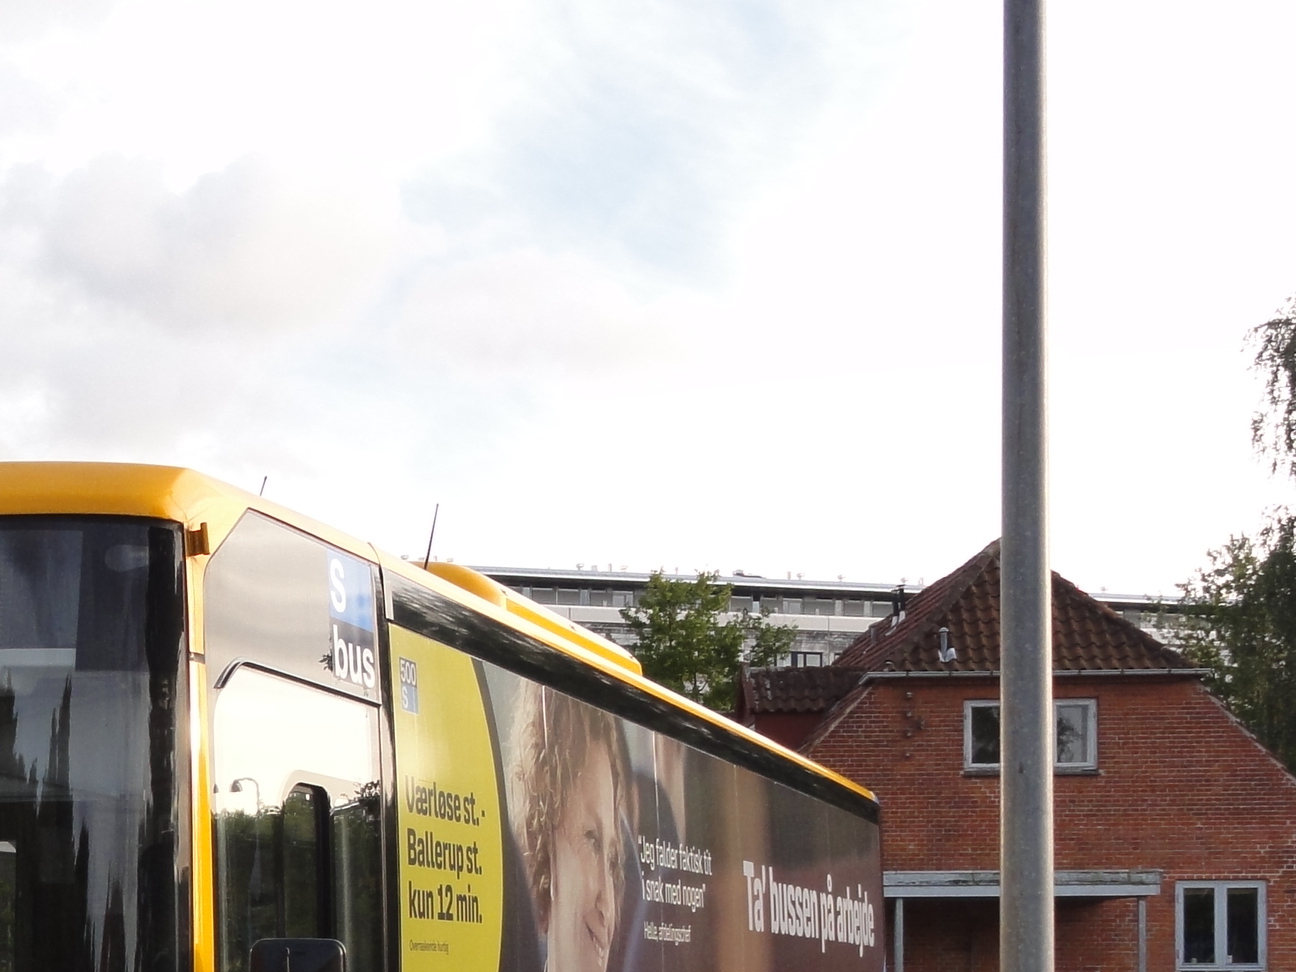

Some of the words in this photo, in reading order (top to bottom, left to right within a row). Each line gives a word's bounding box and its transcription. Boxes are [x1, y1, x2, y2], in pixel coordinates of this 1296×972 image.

[329, 558, 347, 613] S
[332, 624, 376, 688] bus
[400, 660, 417, 686] 500
[405, 775, 461, 823] Værløse
[463, 792, 480, 827] st.
[407, 828, 464, 880] Ballerup
[466, 841, 483, 876] st.
[656, 838, 678, 869] falder
[679, 843, 704, 874] faktisk
[409, 881, 434, 919] kun
[437, 884, 453, 920] 12
[456, 884, 483, 923] min.
[646, 875, 664, 903] snak
[665, 879, 682, 905] med
[743, 860, 766, 932] Ta'
[769, 866, 819, 939] bussen
[820, 873, 835, 953] på
[836, 884, 875, 958] arbejde
